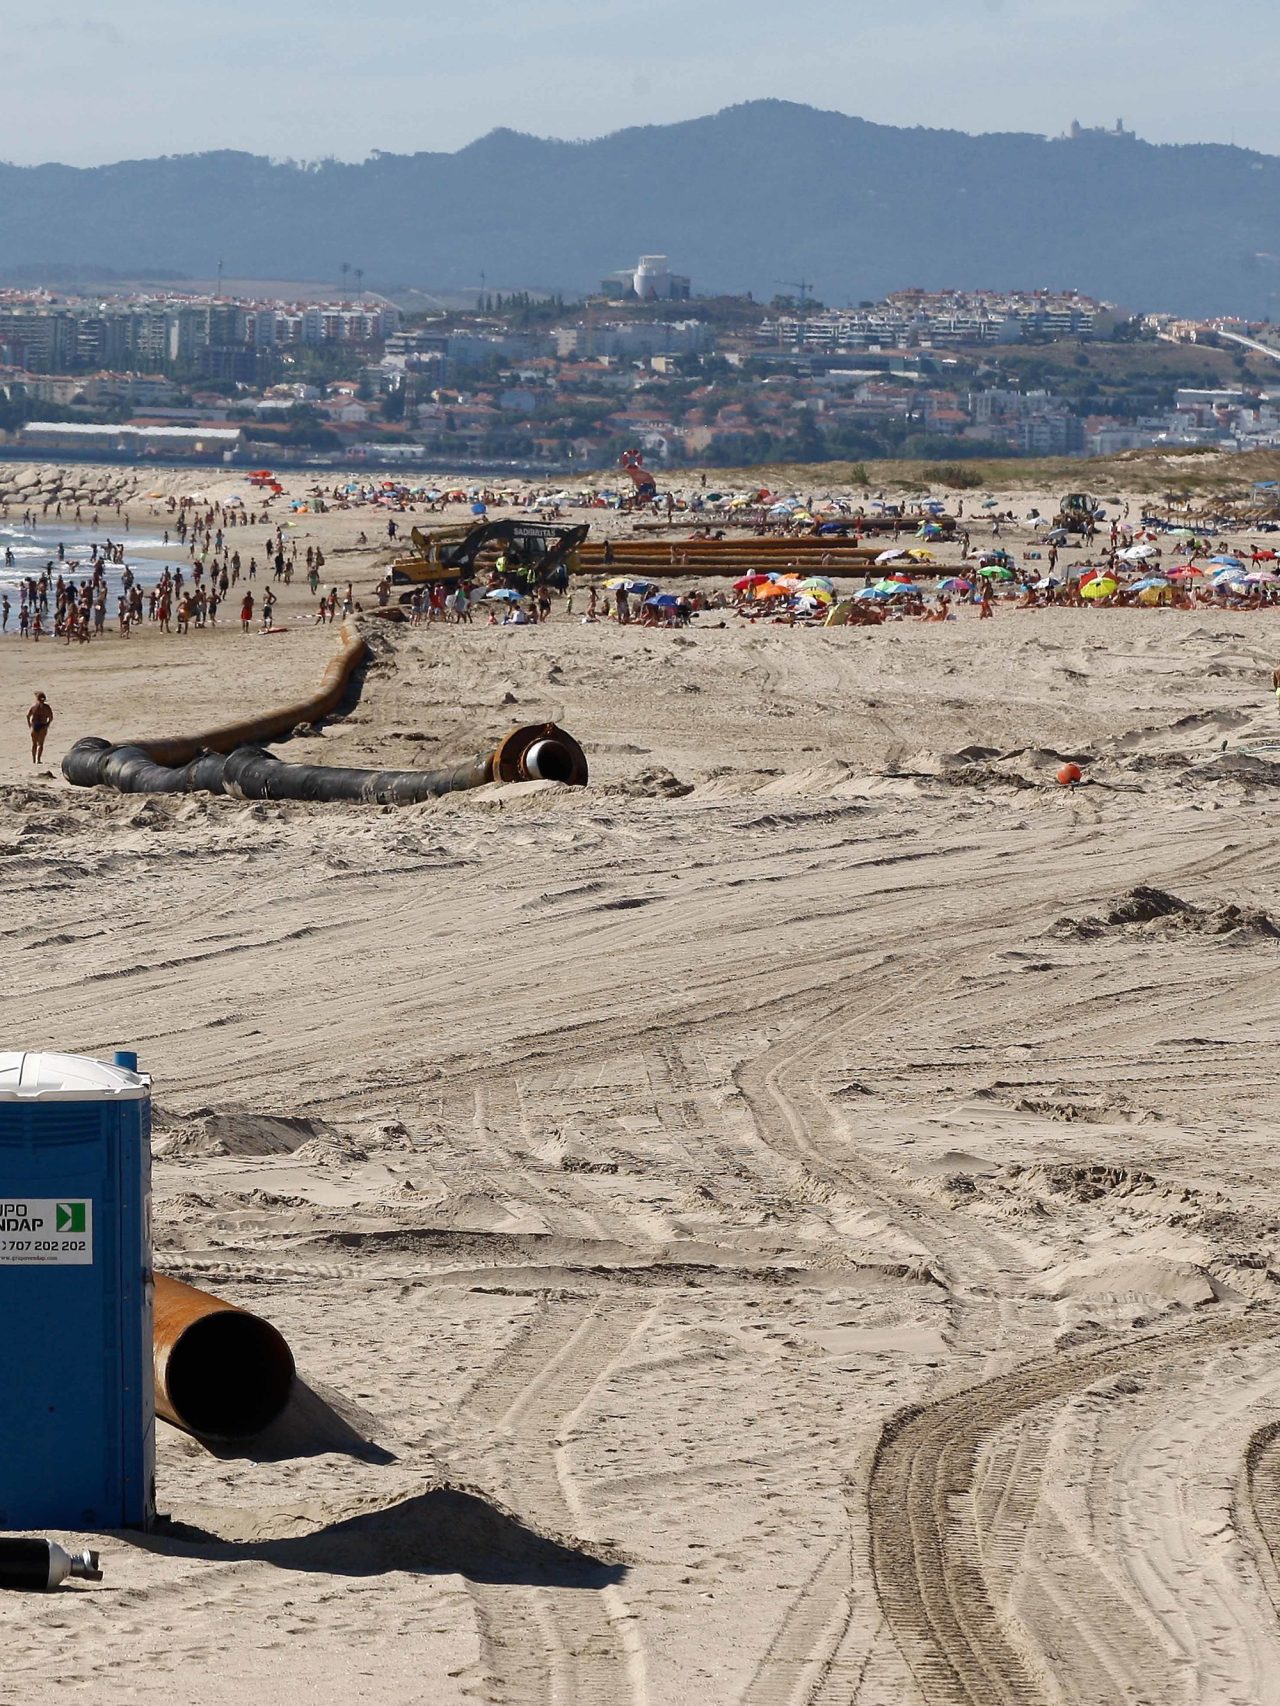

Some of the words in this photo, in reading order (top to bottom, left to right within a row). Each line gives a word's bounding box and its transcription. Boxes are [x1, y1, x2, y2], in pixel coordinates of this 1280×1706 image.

[9, 1240, 32, 1251] 707
[34, 1240, 59, 1251] 202
[61, 1240, 86, 1251] 202
